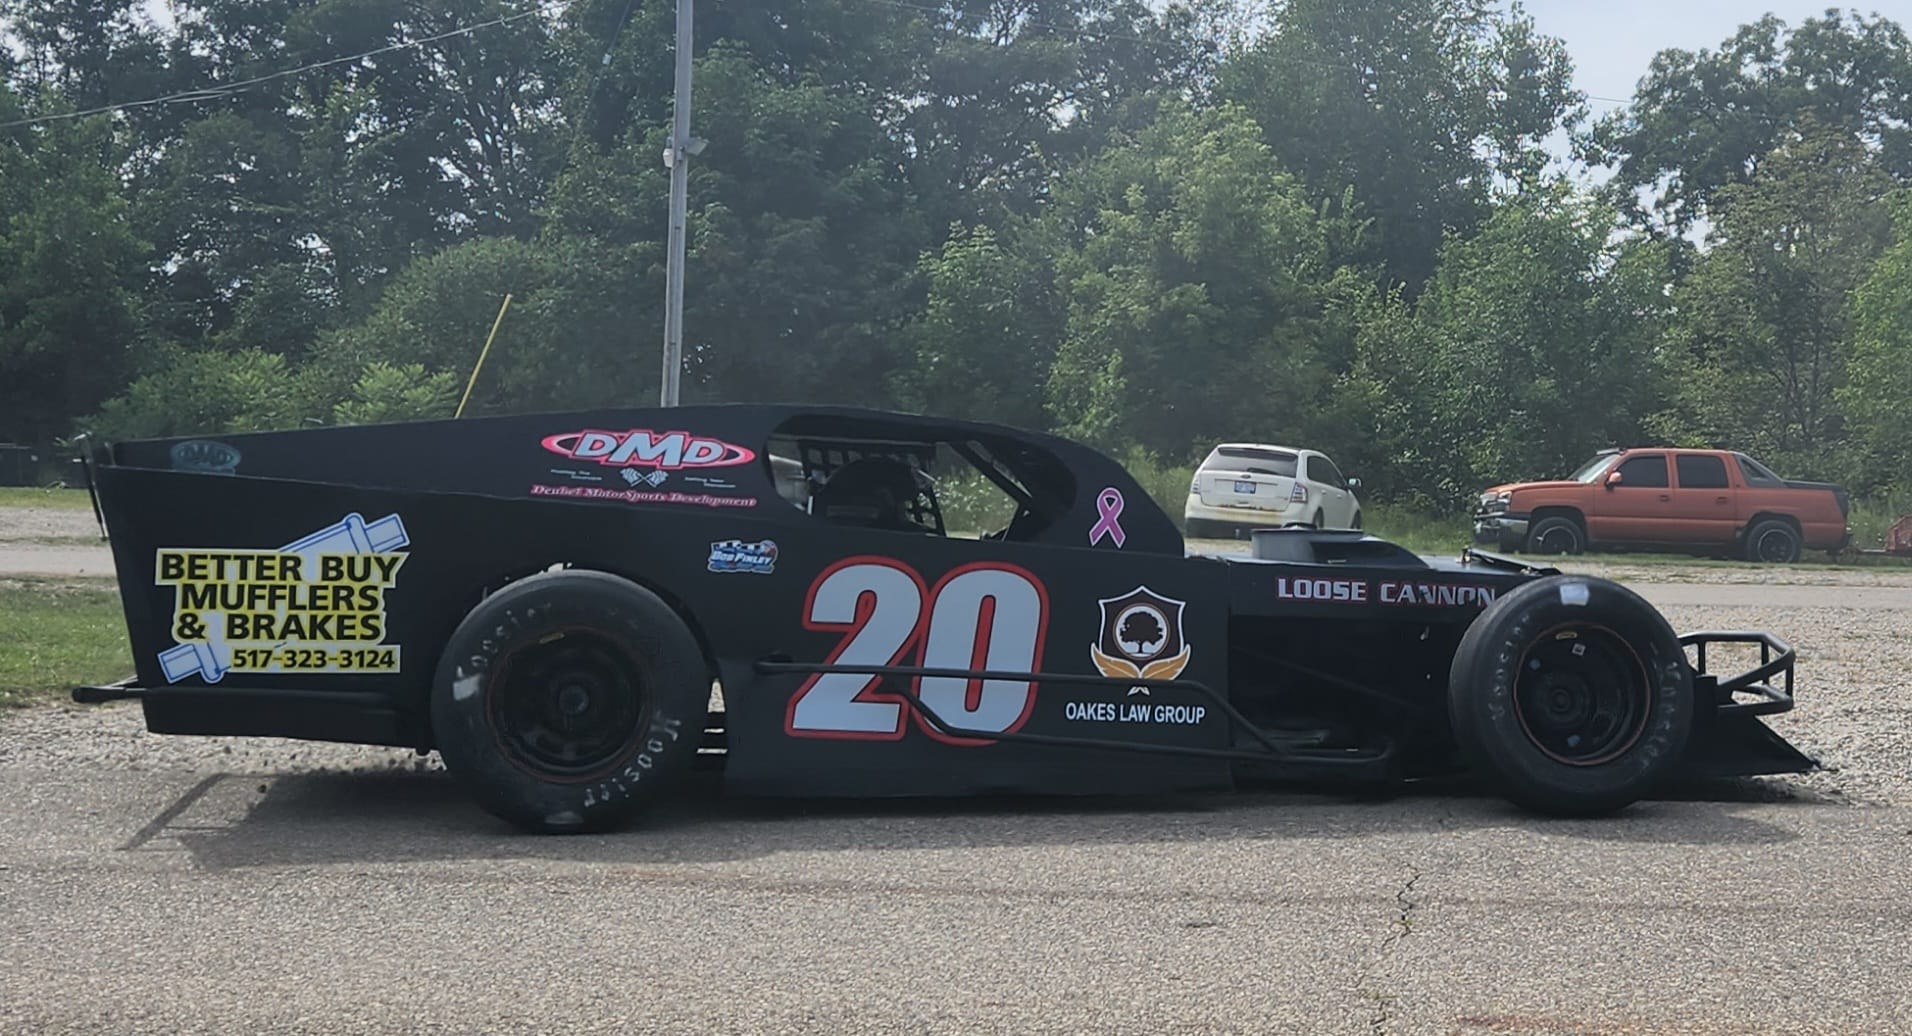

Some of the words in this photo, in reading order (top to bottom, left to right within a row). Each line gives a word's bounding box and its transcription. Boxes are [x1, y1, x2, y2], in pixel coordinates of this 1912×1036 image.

[574, 432, 725, 466] DMD
[586, 487, 666, 503] MotorSports
[670, 492, 757, 507] Development
[160, 552, 303, 582] BETTER
[320, 555, 400, 583] BUY
[180, 583, 380, 612] MUFFLERS
[1277, 577, 1367, 601] LOOSE
[1379, 582, 1496, 606] CANNON
[176, 612, 207, 641] &
[225, 613, 382, 642] BRAKES
[232, 649, 396, 669] 517-323-3124
[785, 556, 1049, 745] 20
[1065, 702, 1116, 722] OAKES
[1119, 703, 1151, 722] LAW
[1154, 704, 1206, 724] GROUP
